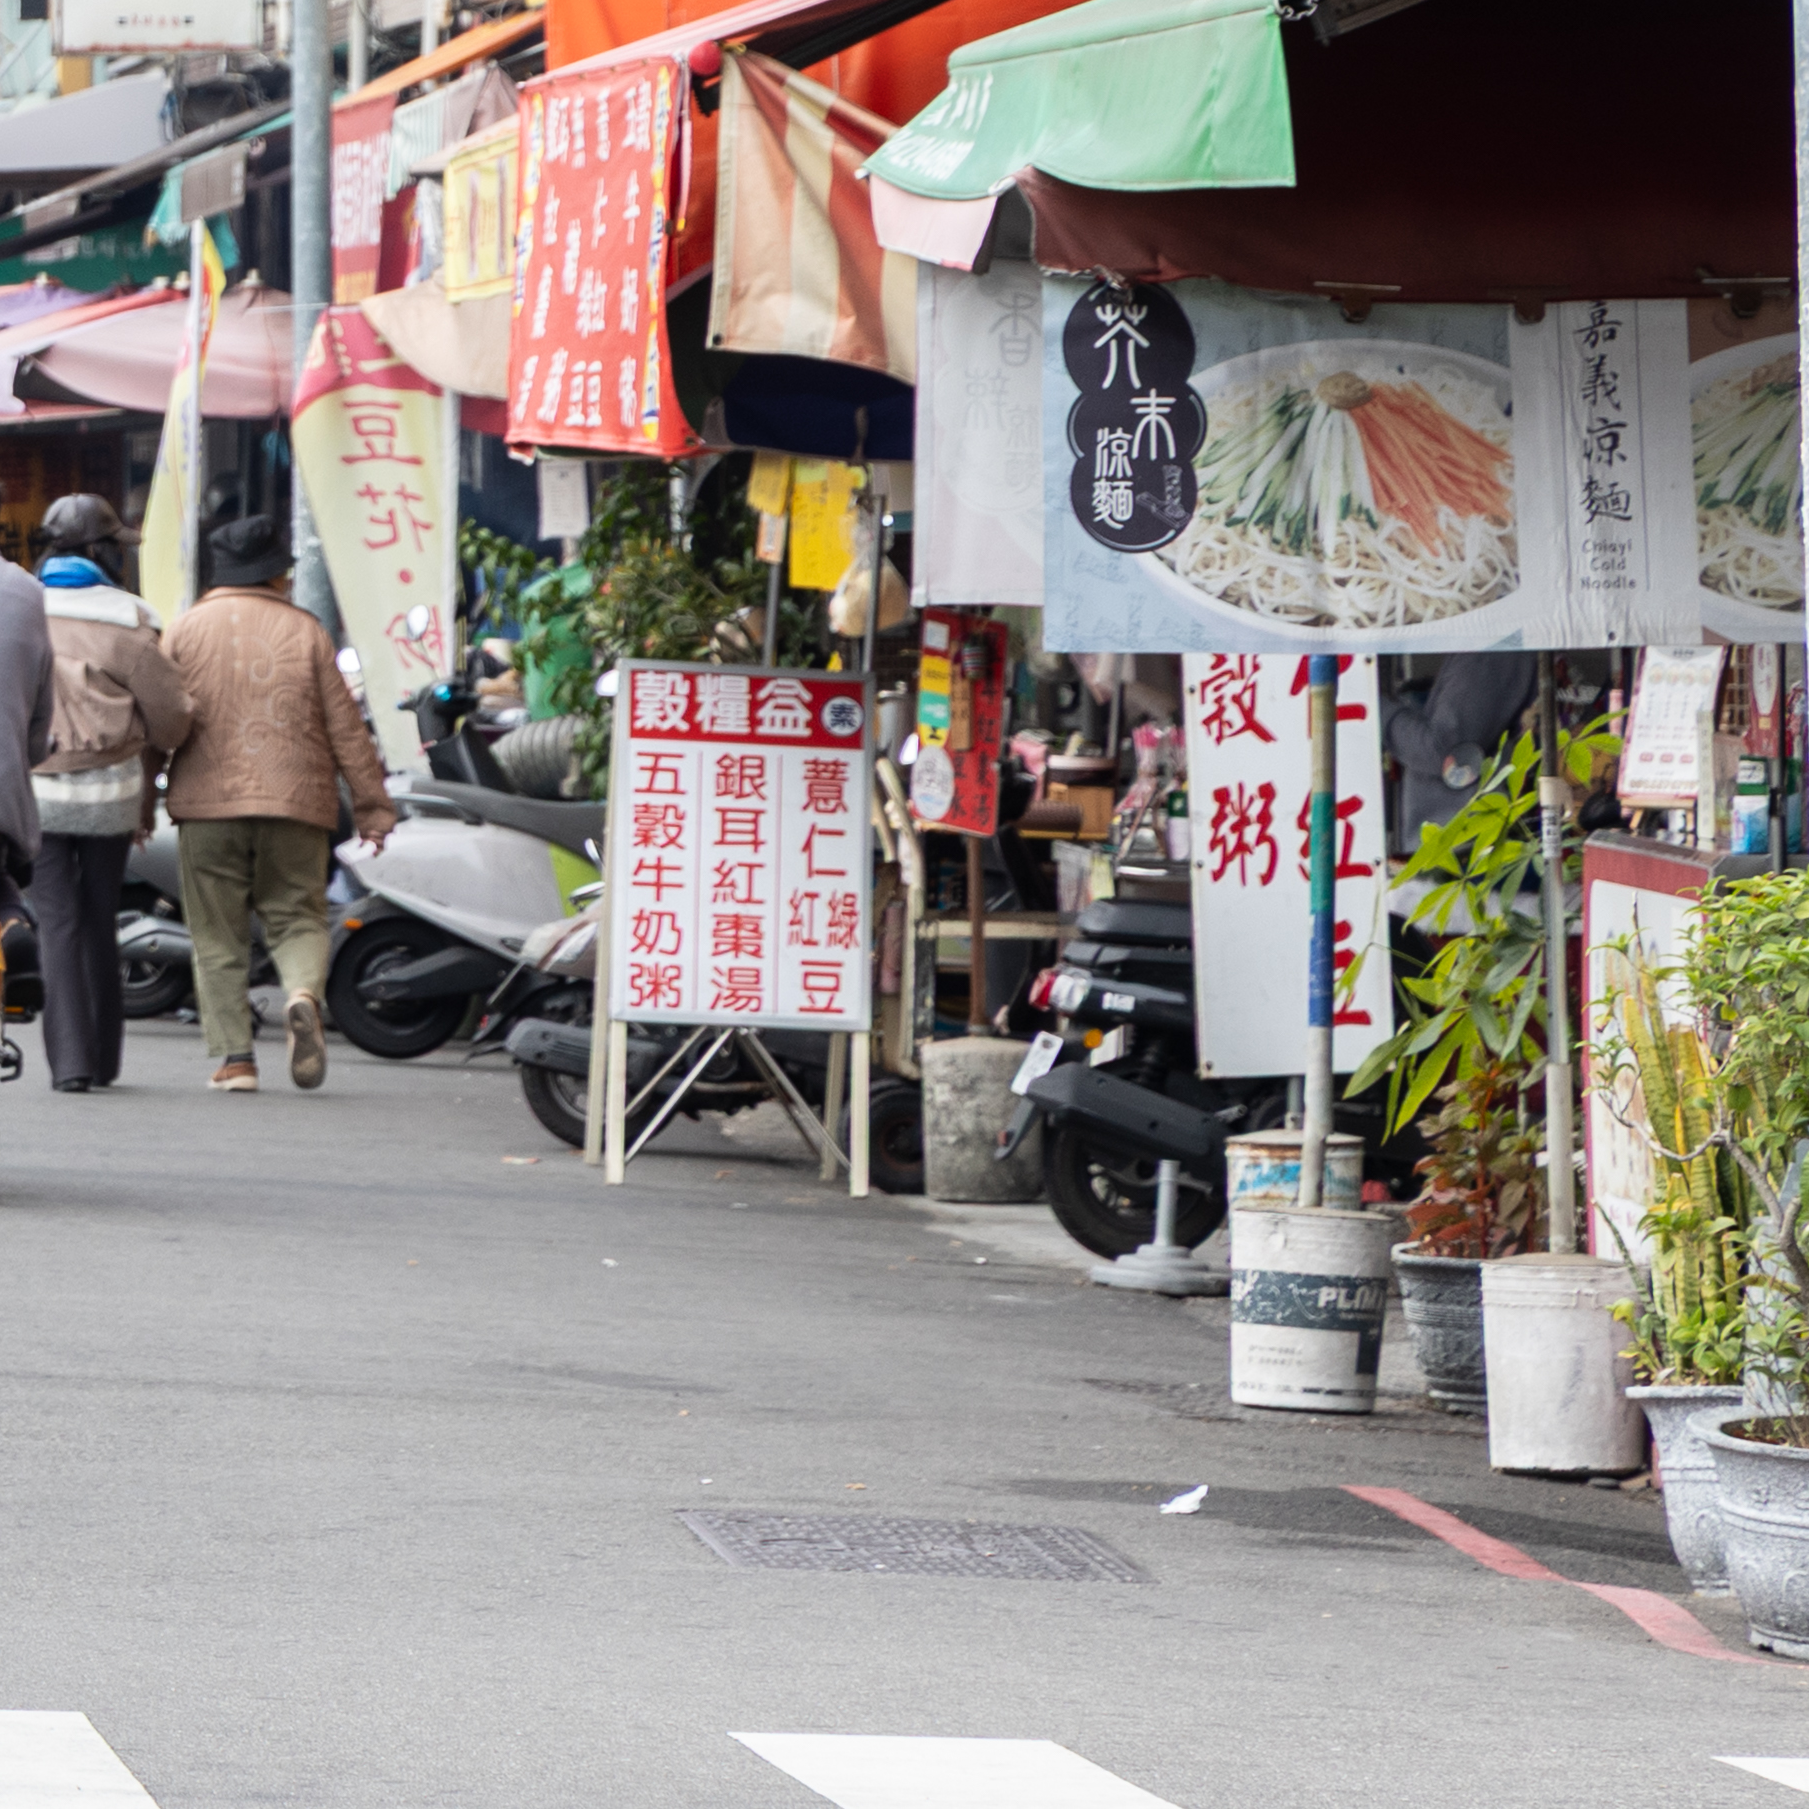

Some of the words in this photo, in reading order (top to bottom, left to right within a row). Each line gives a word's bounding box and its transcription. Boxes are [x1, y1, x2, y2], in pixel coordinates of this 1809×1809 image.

[1576, 298, 1633, 526] 嘉義涼麵
[632, 669, 813, 739] 穀糧益
[828, 700, 859, 731] 素
[628, 751, 687, 1010] 五穀牛奶粥
[709, 753, 767, 1015] 銀耳紅棗湯
